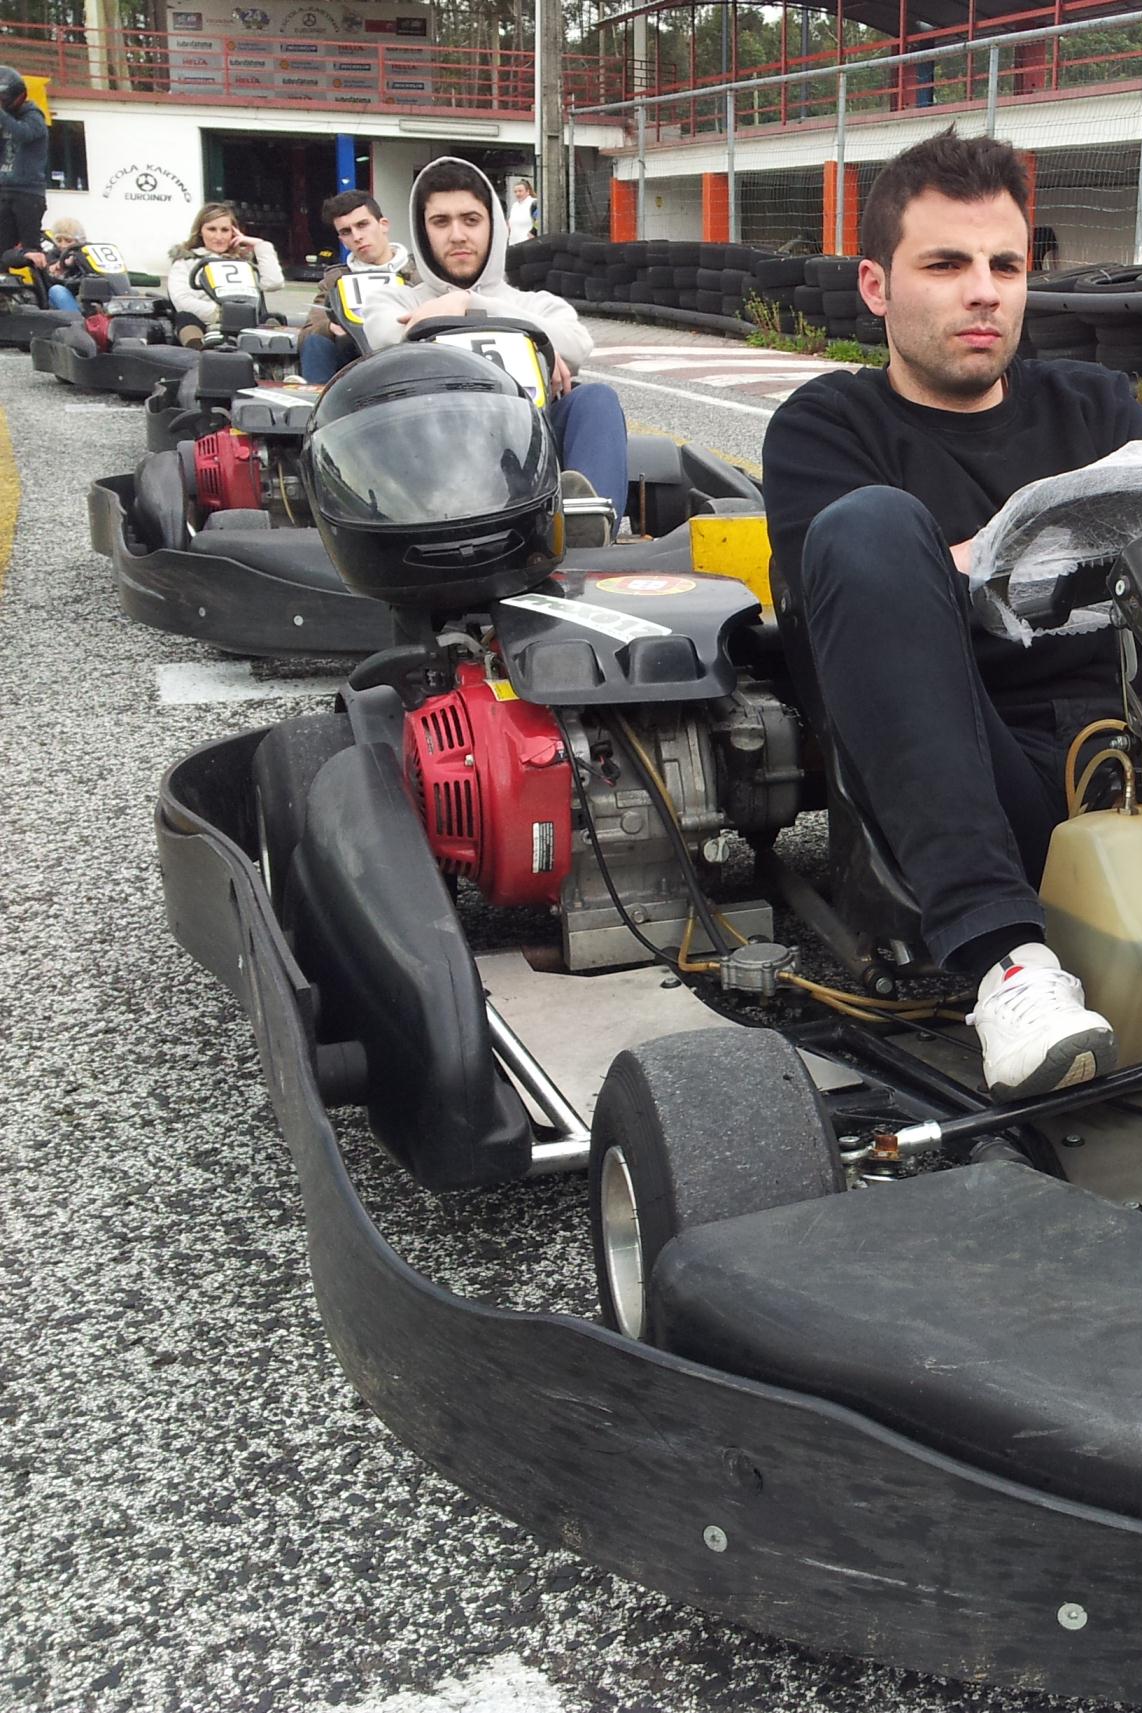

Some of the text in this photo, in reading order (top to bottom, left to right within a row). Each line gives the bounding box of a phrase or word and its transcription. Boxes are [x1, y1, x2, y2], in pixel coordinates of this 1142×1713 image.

[103, 164, 192, 203] ESCOLA KARTING
[124, 192, 173, 202] EUROINDY
[91, 247, 118, 263] 18
[221, 264, 242, 283] 2
[471, 339, 505, 371] 5
